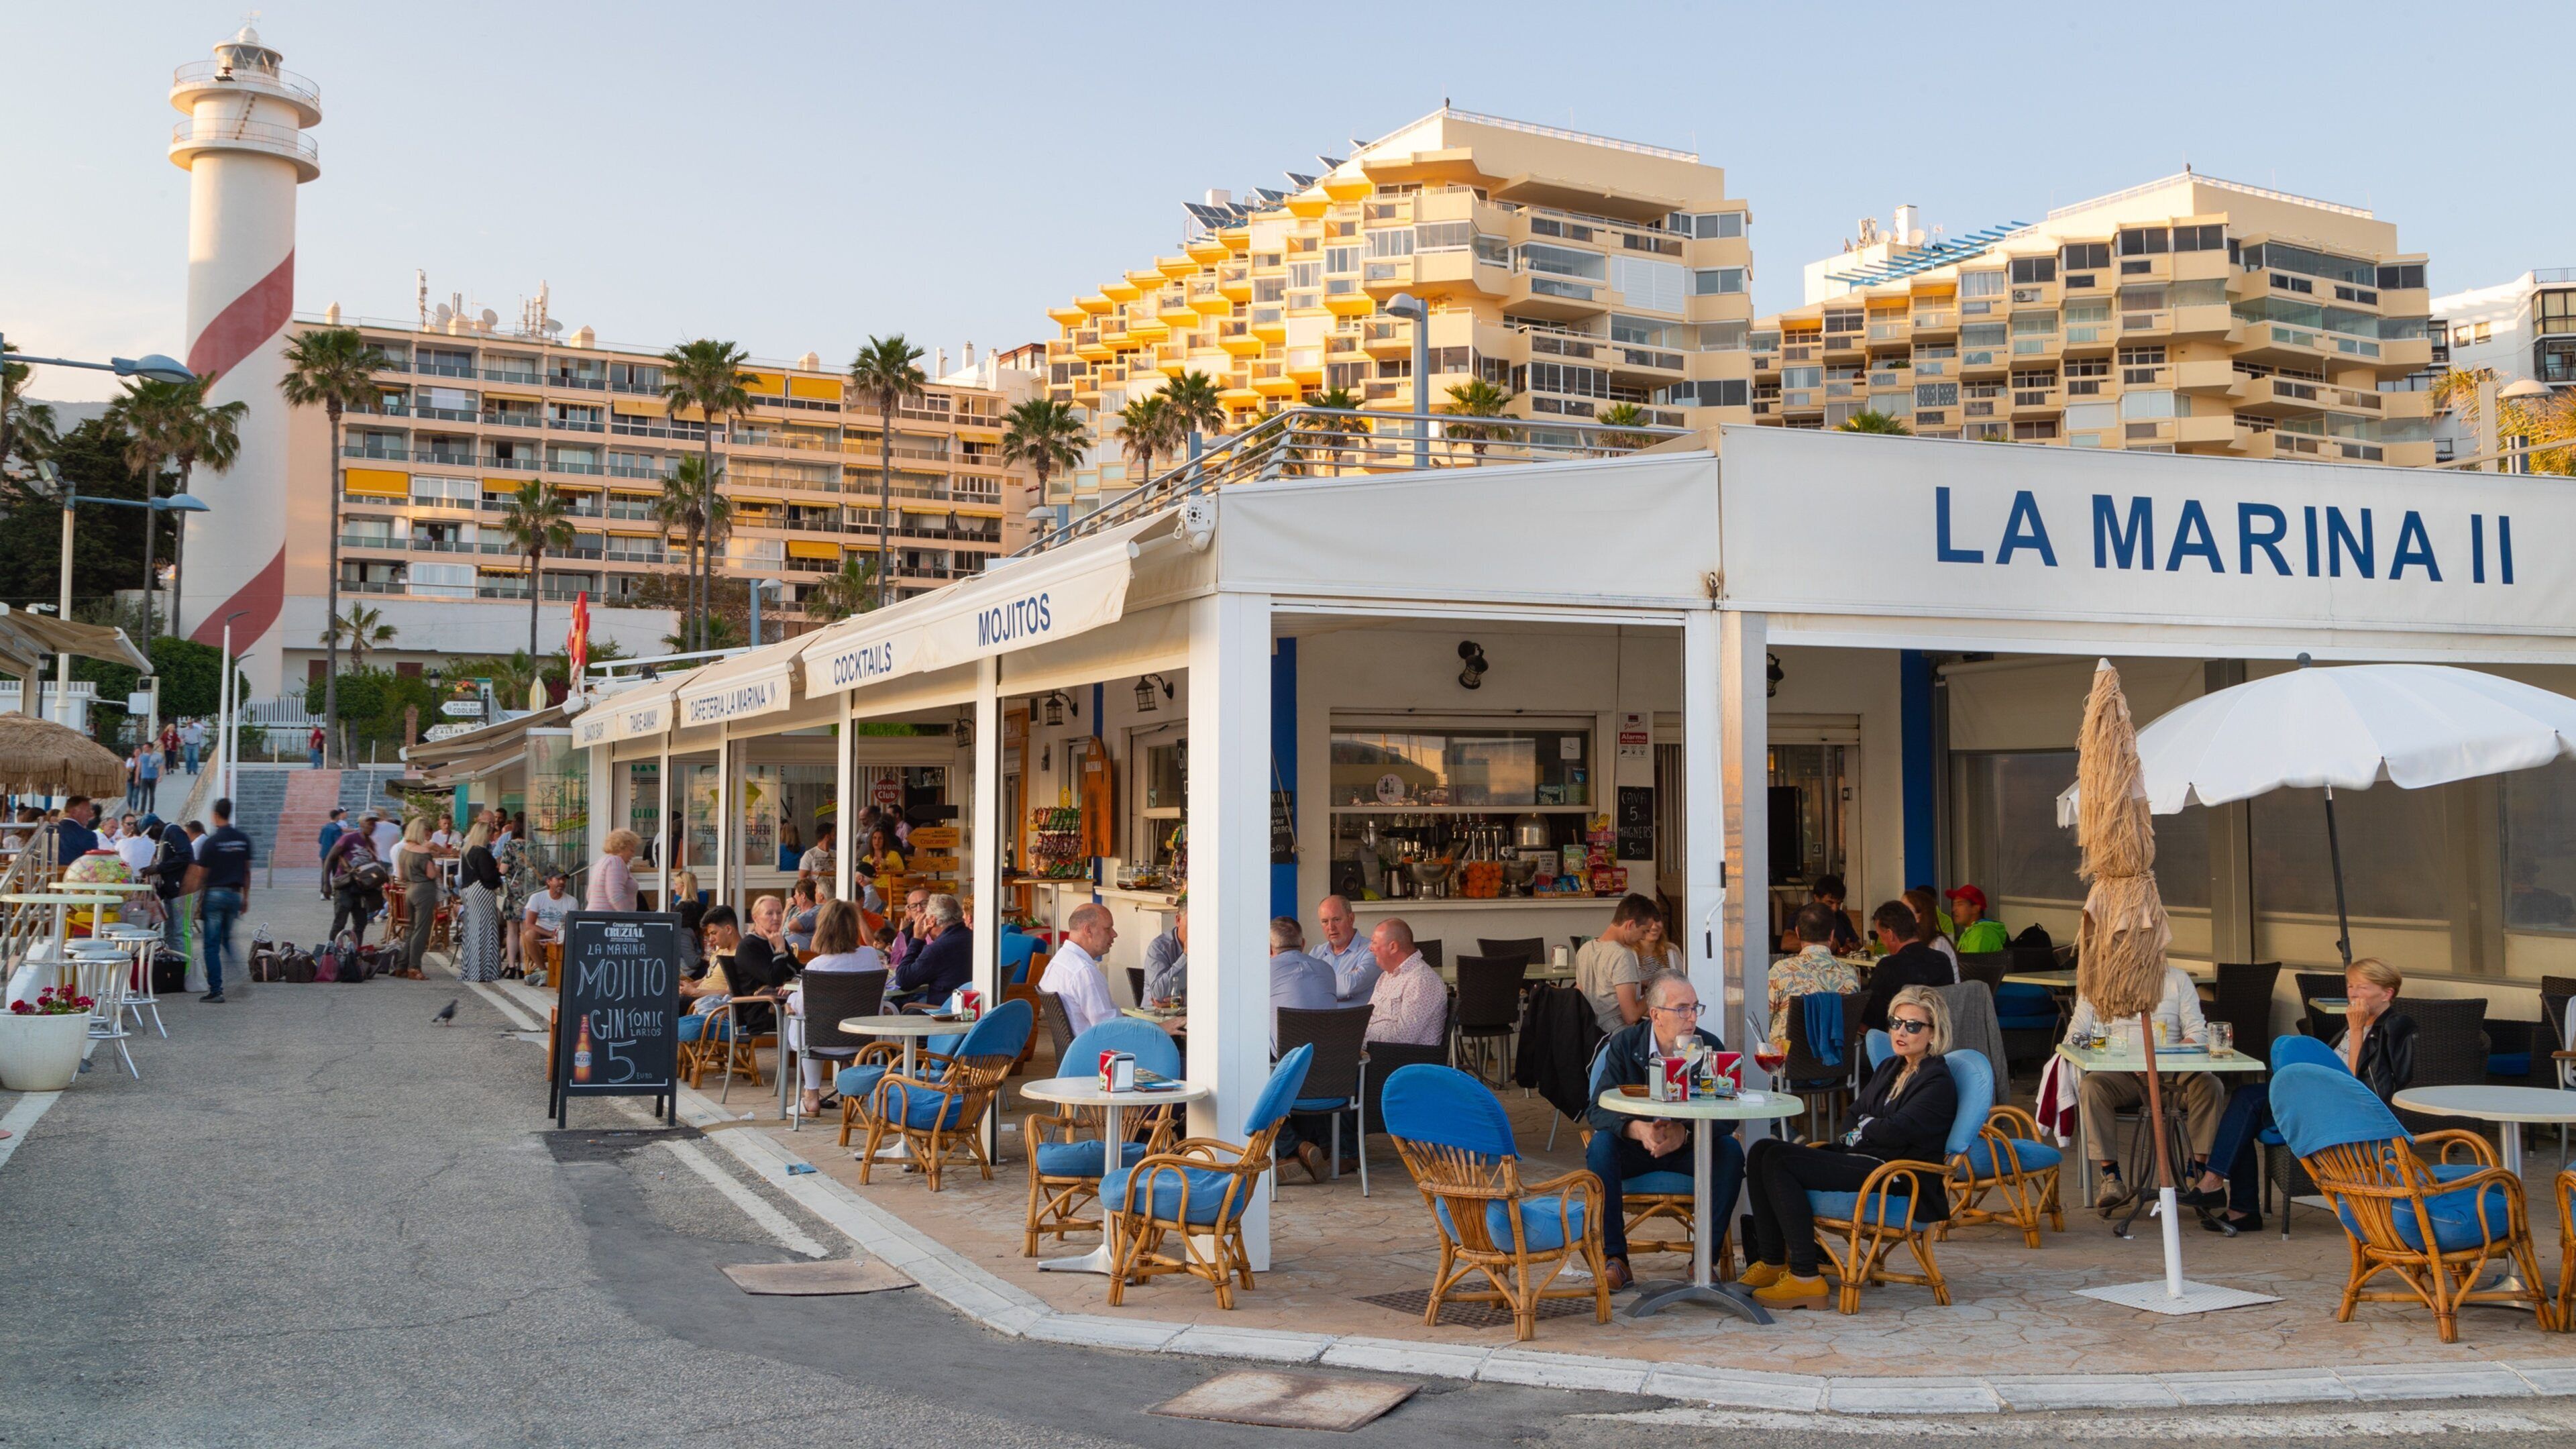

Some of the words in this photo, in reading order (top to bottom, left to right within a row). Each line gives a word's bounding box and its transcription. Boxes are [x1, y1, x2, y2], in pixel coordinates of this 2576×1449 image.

[1935, 486, 2058, 568] LA
[2091, 494, 2444, 582] MARINA
[2470, 514, 2514, 585] II
[978, 593, 1051, 647] MOJITOS
[834, 642, 892, 686] COCKTAILS
[691, 694, 724, 722] CAFETERIA
[727, 692, 735, 714] LA
[737, 684, 766, 712] MARINA
[584, 722, 596, 742] SNACK
[596, 721, 604, 739] BAR
[630, 712, 643, 734] TAKE
[643, 709, 657, 731] AWAY
[877, 790, 896, 800] Club
[1621, 792, 1647, 804] CAVA
[1618, 826, 1653, 839] MAGNERS
[604, 927, 645, 938] CRUZIAL
[587, 944, 602, 955] LA
[606, 943, 646, 955] MARINA
[577, 958, 666, 1002] MOJITO
[590, 1008, 625, 1040] GIN
[627, 1008, 663, 1028] TONIC
[631, 1028, 661, 1037] LARIOS
[608, 1039, 637, 1084] 5
